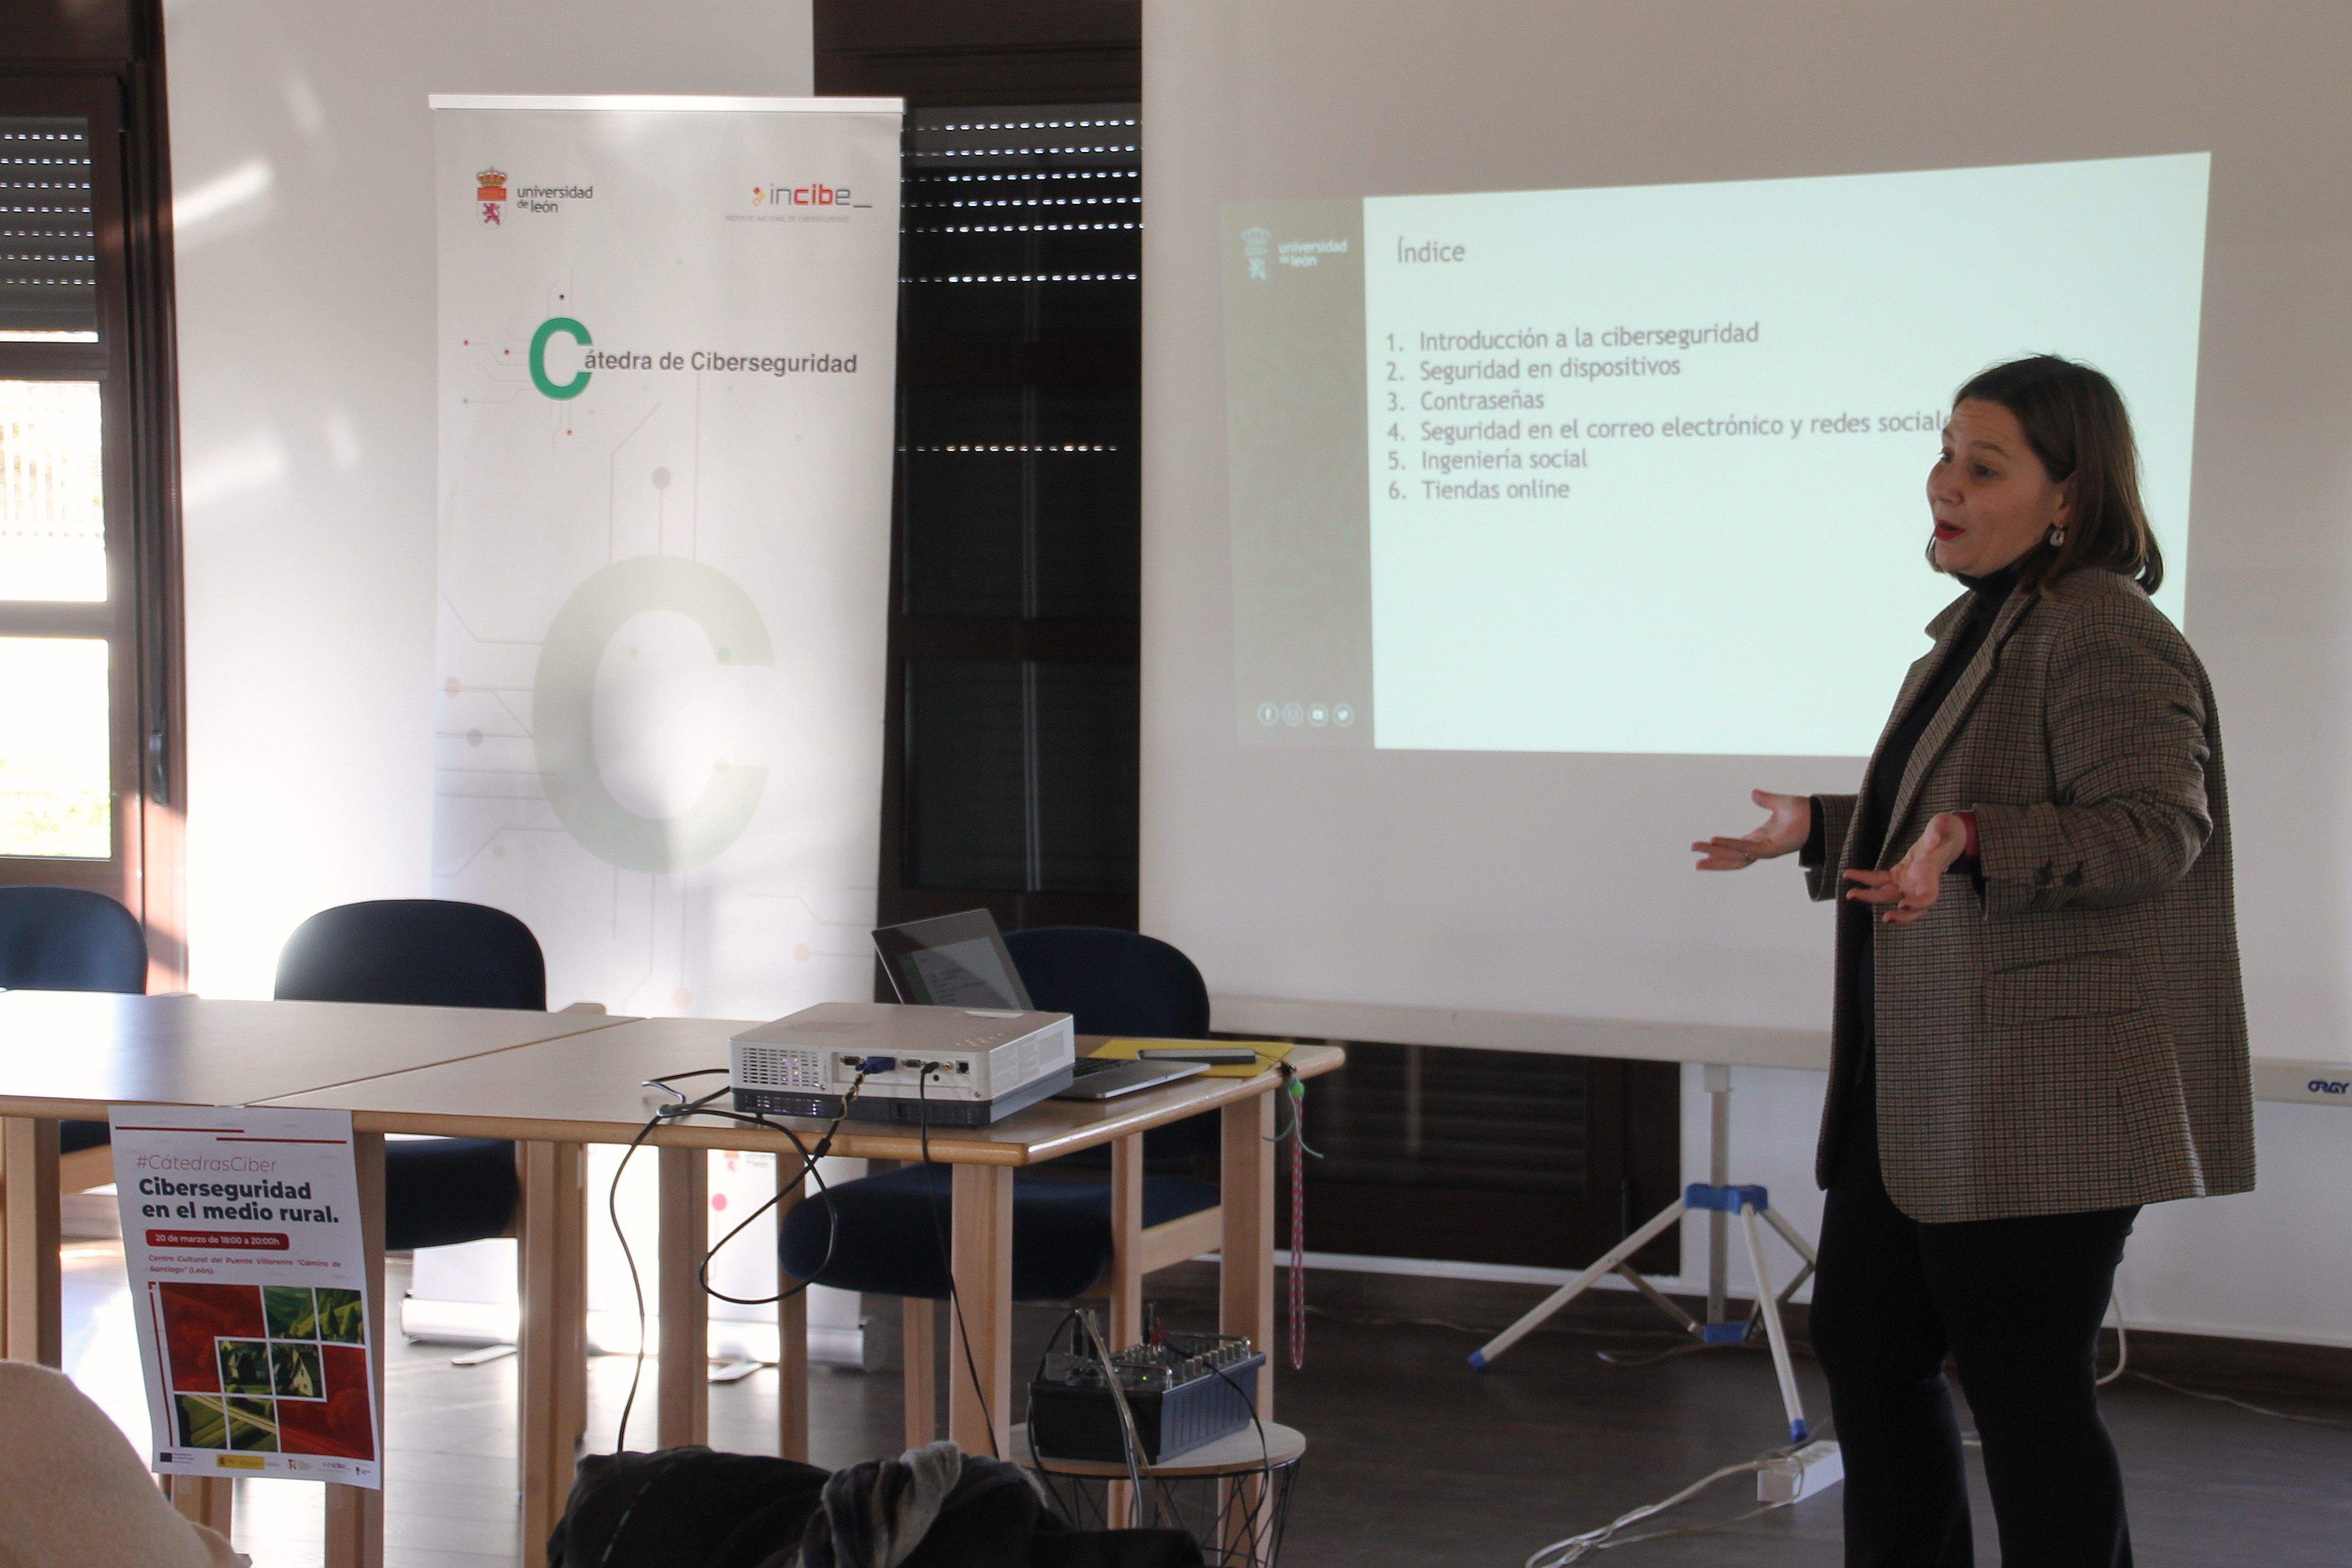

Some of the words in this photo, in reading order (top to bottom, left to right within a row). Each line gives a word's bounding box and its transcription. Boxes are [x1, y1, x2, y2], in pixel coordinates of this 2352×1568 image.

[517, 186, 593, 199] universidad
[517, 199, 529, 209] de
[531, 200, 558, 213] león
[1398, 236, 1466, 263] Índice
[1387, 334, 1403, 352] 1.
[1420, 329, 1547, 351] Introducción
[1556, 335, 1567, 348] a
[1576, 328, 1593, 347] la
[1602, 322, 1759, 349] ciberseguridad
[660, 352, 684, 371] de
[691, 352, 857, 377] Ciberseguridad
[1387, 363, 1403, 381] 2.
[1420, 361, 1520, 384] Seguridad
[1528, 365, 1551, 379] en
[1560, 356, 1680, 383] dispositivos
[1387, 393, 1404, 410] 3.
[1420, 390, 1544, 411] Contraseñas
[1387, 423, 1404, 440] 4.
[1421, 421, 1520, 444] Seguridad
[1529, 426, 1551, 439] en
[1560, 420, 1577, 439] el
[1587, 422, 1653, 438] correo
[1662, 415, 1783, 437] electrónico
[1790, 418, 1803, 439] y
[1811, 413, 1870, 434] redes
[1388, 452, 1406, 470] 5.
[1422, 449, 1521, 473] Ingeniería
[1529, 449, 1587, 469] social
[1389, 481, 1406, 499] 6.
[1423, 480, 1499, 499] Tiendas
[1507, 479, 1570, 498] online
[137, 1155, 276, 1172] #CátedrasCiber
[139, 1177, 311, 1201] Ciberseguridad
[142, 1204, 170, 1218] en
[176, 1201, 196, 1219] el
[203, 1201, 273, 1221] medio
[280, 1206, 339, 1223] rural.
